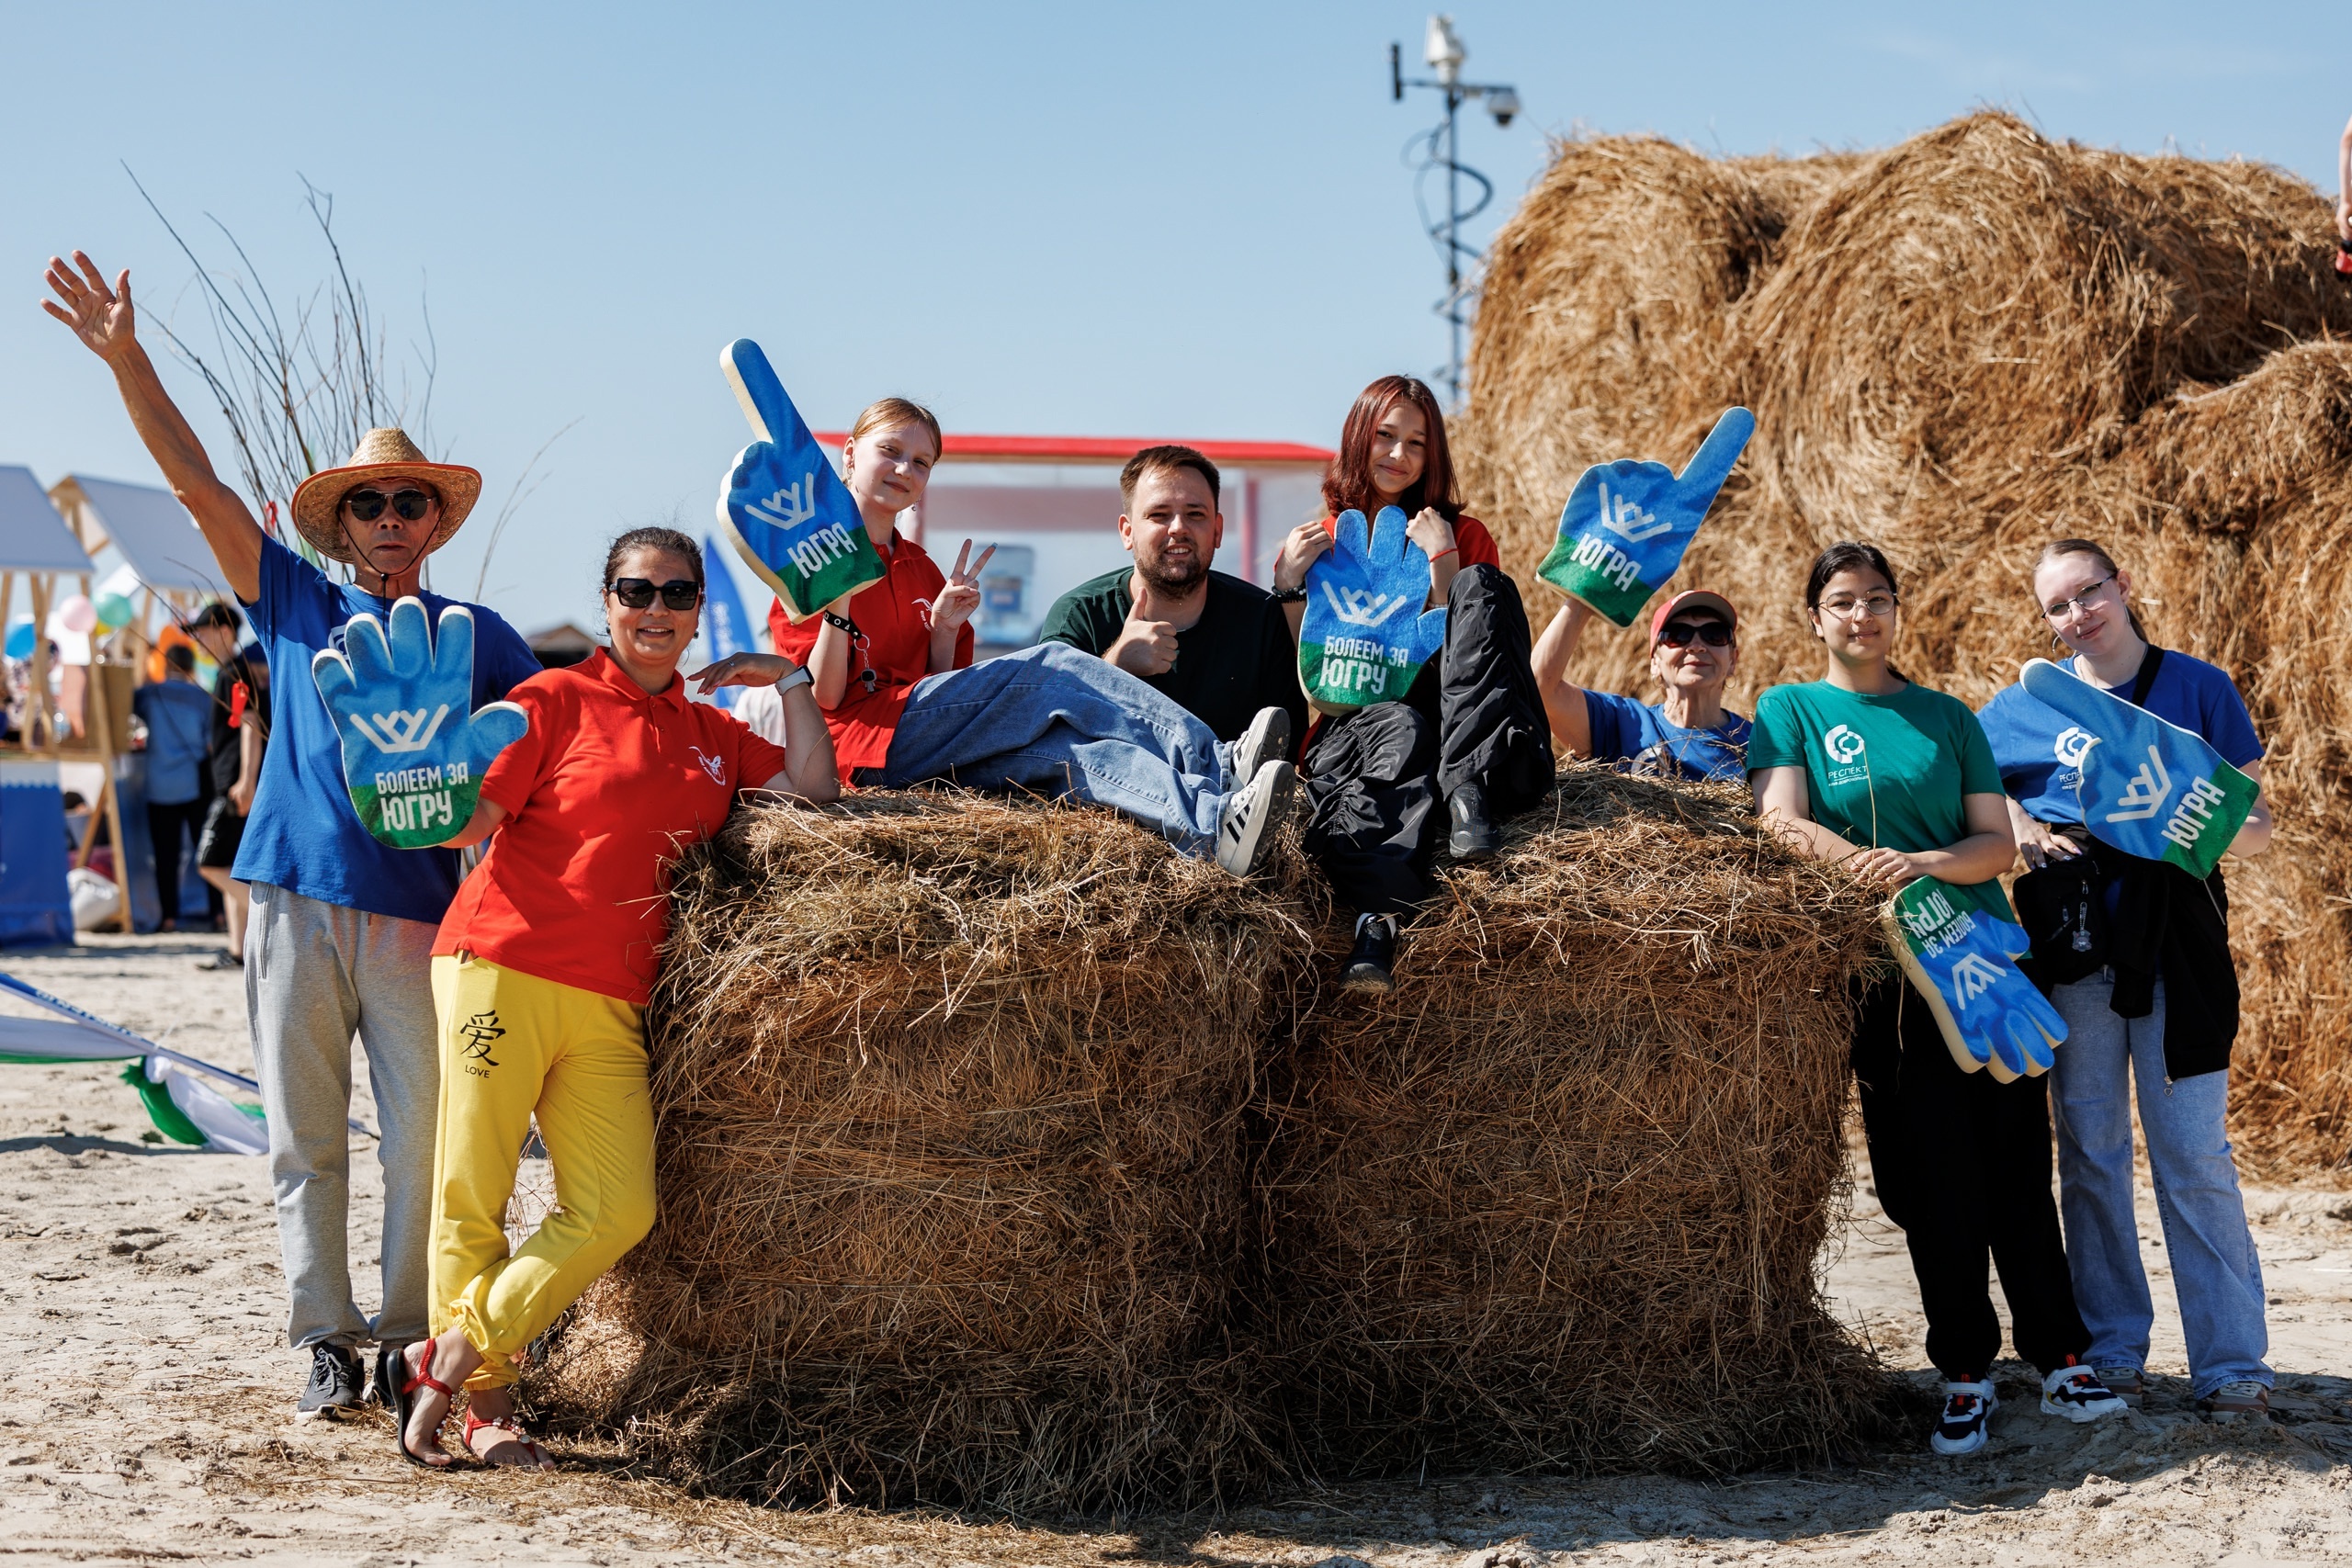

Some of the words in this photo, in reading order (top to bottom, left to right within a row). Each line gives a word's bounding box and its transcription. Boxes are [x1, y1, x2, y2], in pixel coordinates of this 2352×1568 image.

[786, 522, 858, 580] ЮГРА
[1570, 533, 1642, 592] ЮГРА
[1324, 636, 1385, 663] БОЛЕЕМ
[1388, 648, 1409, 668] ЗА
[1319, 657, 1387, 694] ЮГРУ
[375, 765, 442, 795] БОЛЕЕМ
[447, 761, 469, 785] ЗА
[1828, 765, 1867, 779] РЕСПЕКТ
[379, 790, 453, 831] ЮГРУ
[2160, 775, 2226, 850] ЮГРА
[1903, 888, 1955, 940] ЮГРУ
[1938, 910, 1976, 949] БОЛЕЕМ
[1921, 935, 1943, 959] ЗА
[460, 1010, 506, 1066] 爱
[465, 1065, 491, 1078] LOVE
